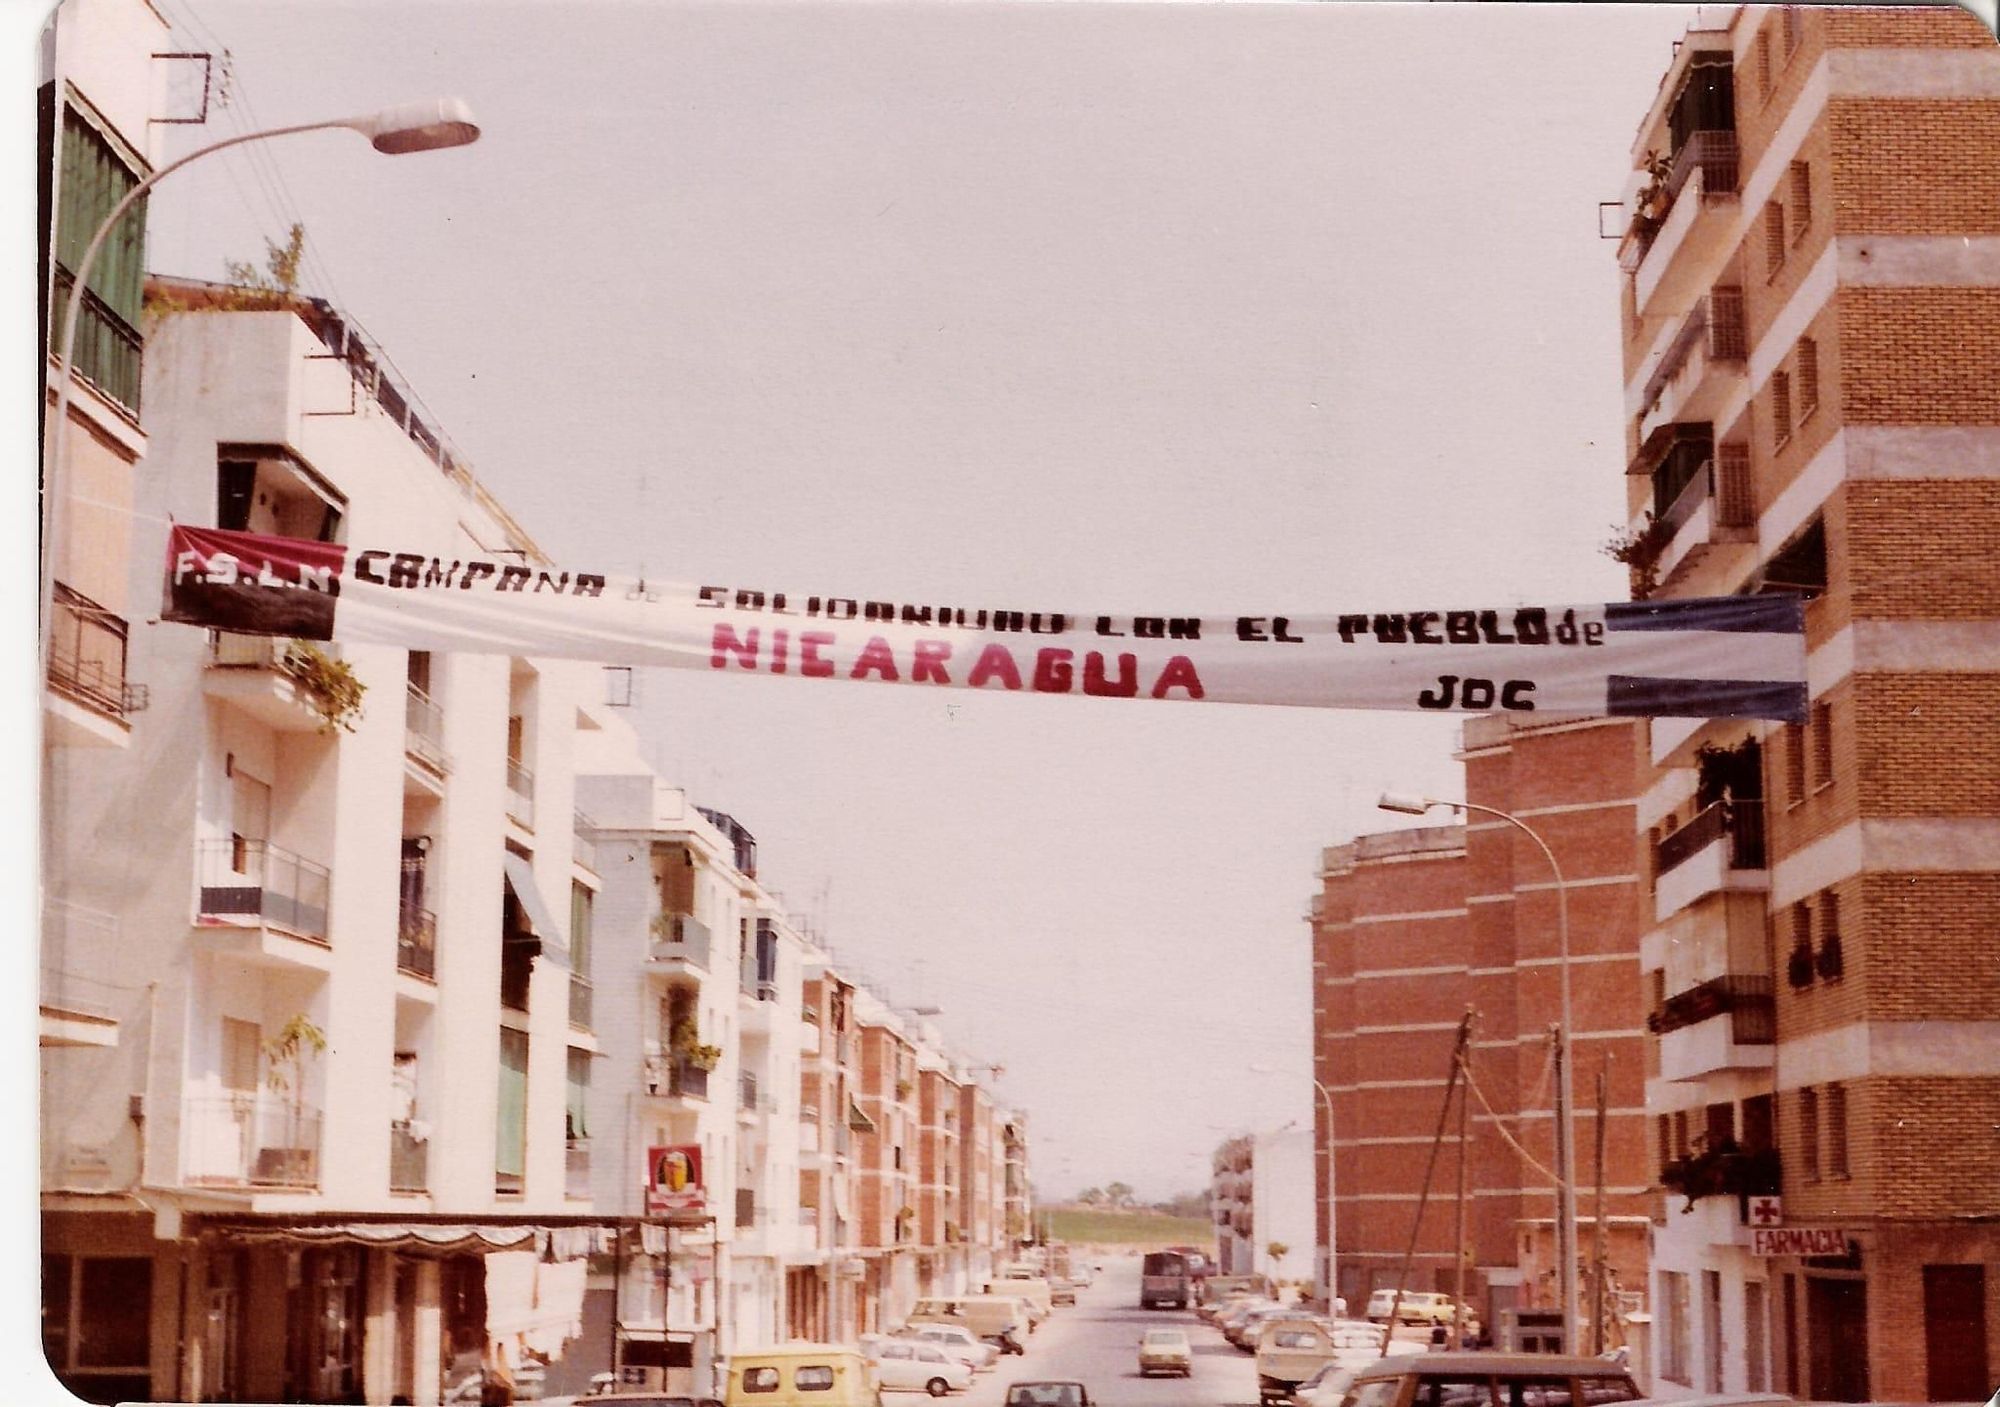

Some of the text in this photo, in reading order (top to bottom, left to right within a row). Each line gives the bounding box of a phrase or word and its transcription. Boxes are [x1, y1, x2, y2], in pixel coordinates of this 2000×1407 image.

[1236, 617, 1304, 643] EL
[1338, 607, 1550, 645] PUEBLO
[1555, 608, 1604, 646] de
[710, 623, 1205, 699] NICARAGUA
[1755, 1229, 1846, 1255] FARMACIA
